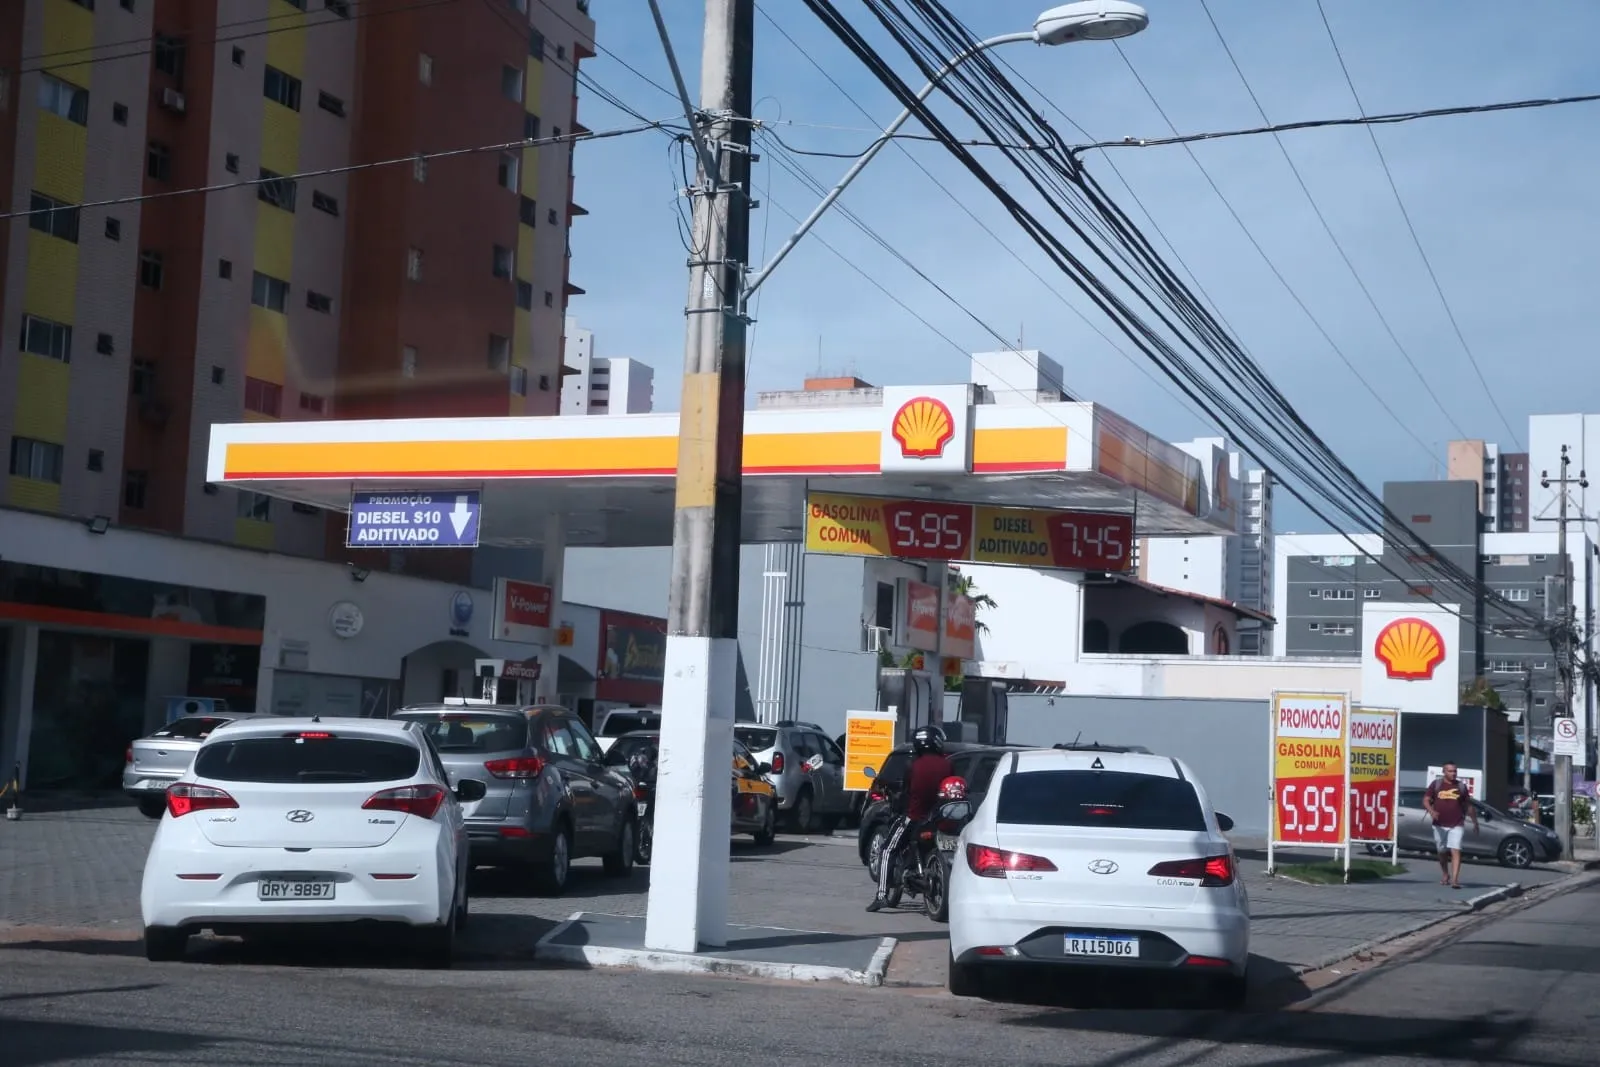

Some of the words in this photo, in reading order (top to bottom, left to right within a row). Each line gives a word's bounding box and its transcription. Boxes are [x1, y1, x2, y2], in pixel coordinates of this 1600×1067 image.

[369, 495, 432, 507] PROMOÇÃO
[357, 511, 409, 524] DIESEL
[413, 511, 441, 524] S10
[811, 503, 881, 522] GASOLINA
[993, 517, 1034, 534] DIESEL
[357, 528, 439, 541] ADITIVADO
[819, 526, 871, 544] COMUM
[979, 538, 1048, 556] ADITIVADO
[1280, 704, 1341, 733] PROMOÇÃO
[1350, 720, 1393, 744] ROMOÇÃO
[1279, 743, 1341, 758] GASOLINA
[1294, 760, 1326, 769] COMUM
[1350, 752, 1390, 766] DIESEL
